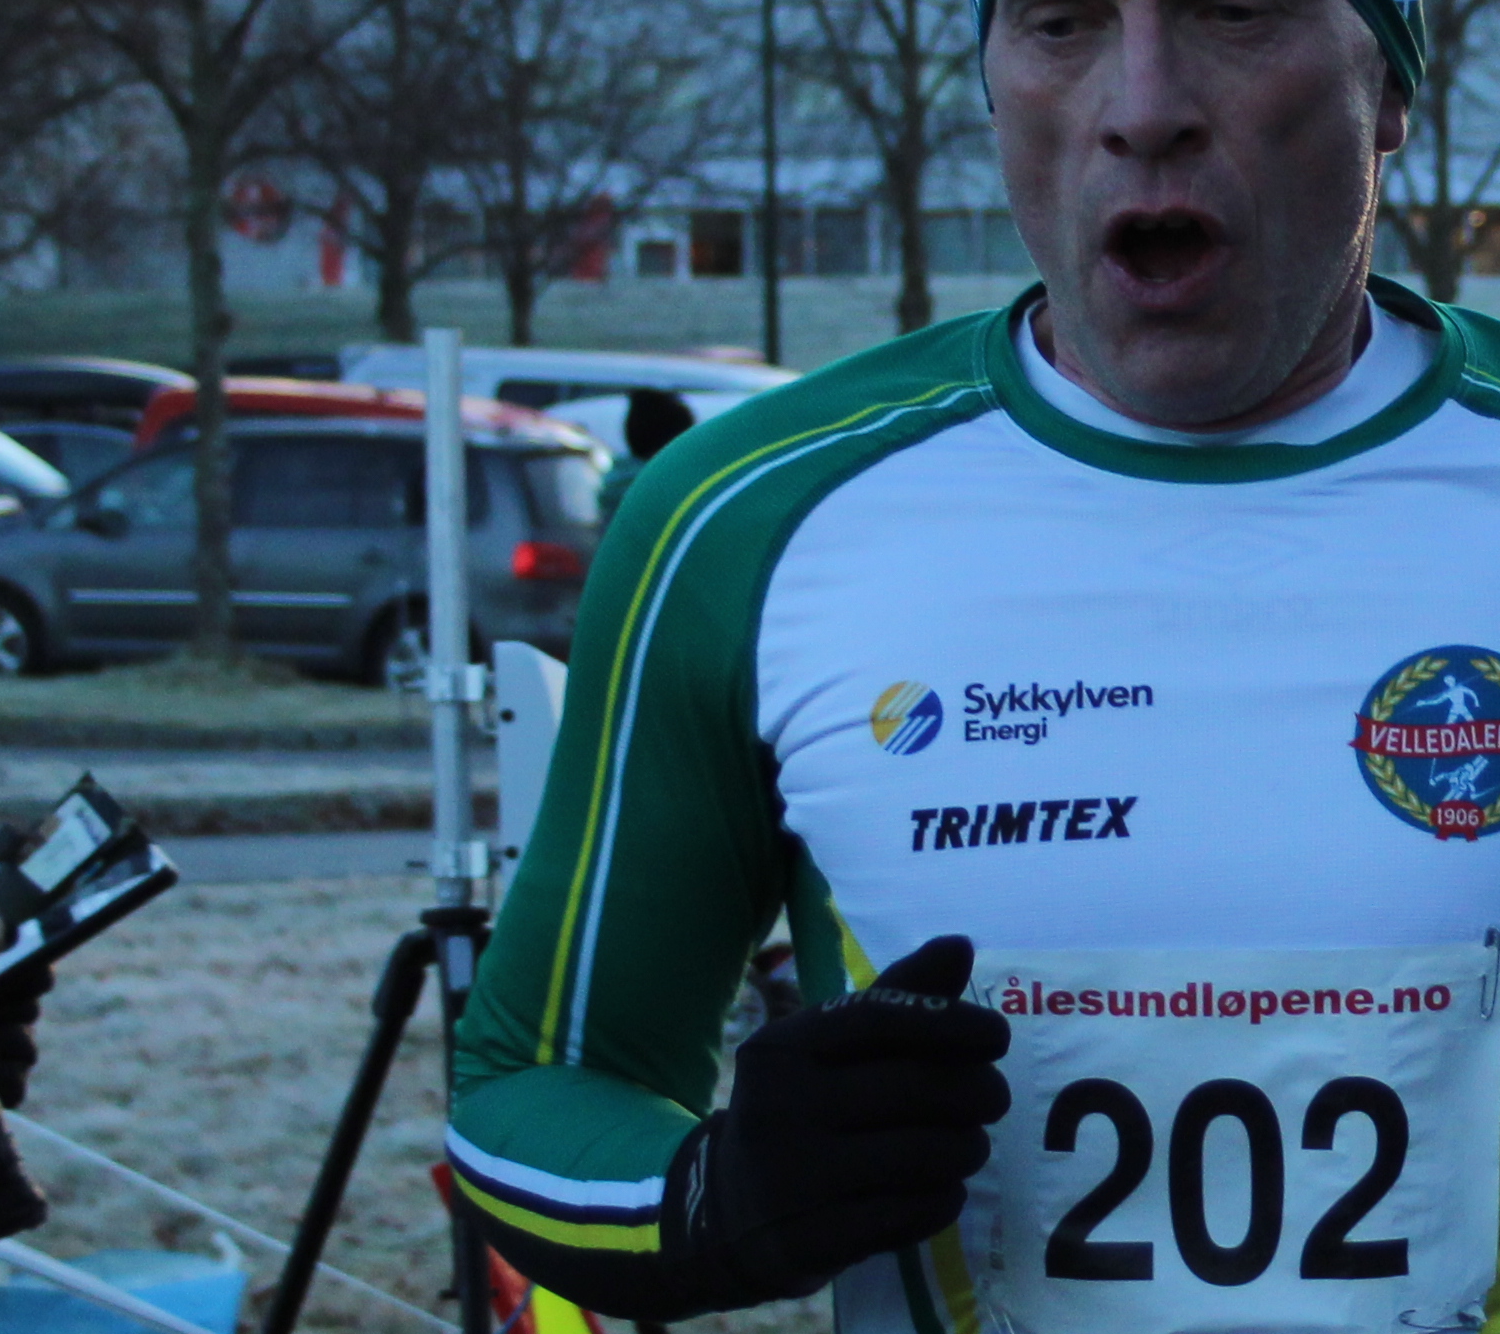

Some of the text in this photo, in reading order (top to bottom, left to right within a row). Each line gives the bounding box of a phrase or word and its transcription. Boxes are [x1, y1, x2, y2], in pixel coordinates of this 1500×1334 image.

[963, 679, 1155, 720] Sykkylven
[963, 716, 1048, 746] Energi
[910, 795, 1139, 852] TRIMTEX
[1435, 807, 1480, 827] 1906
[1000, 975, 1452, 1025] ålesundløpene.no
[1042, 1075, 1410, 1287] 202
